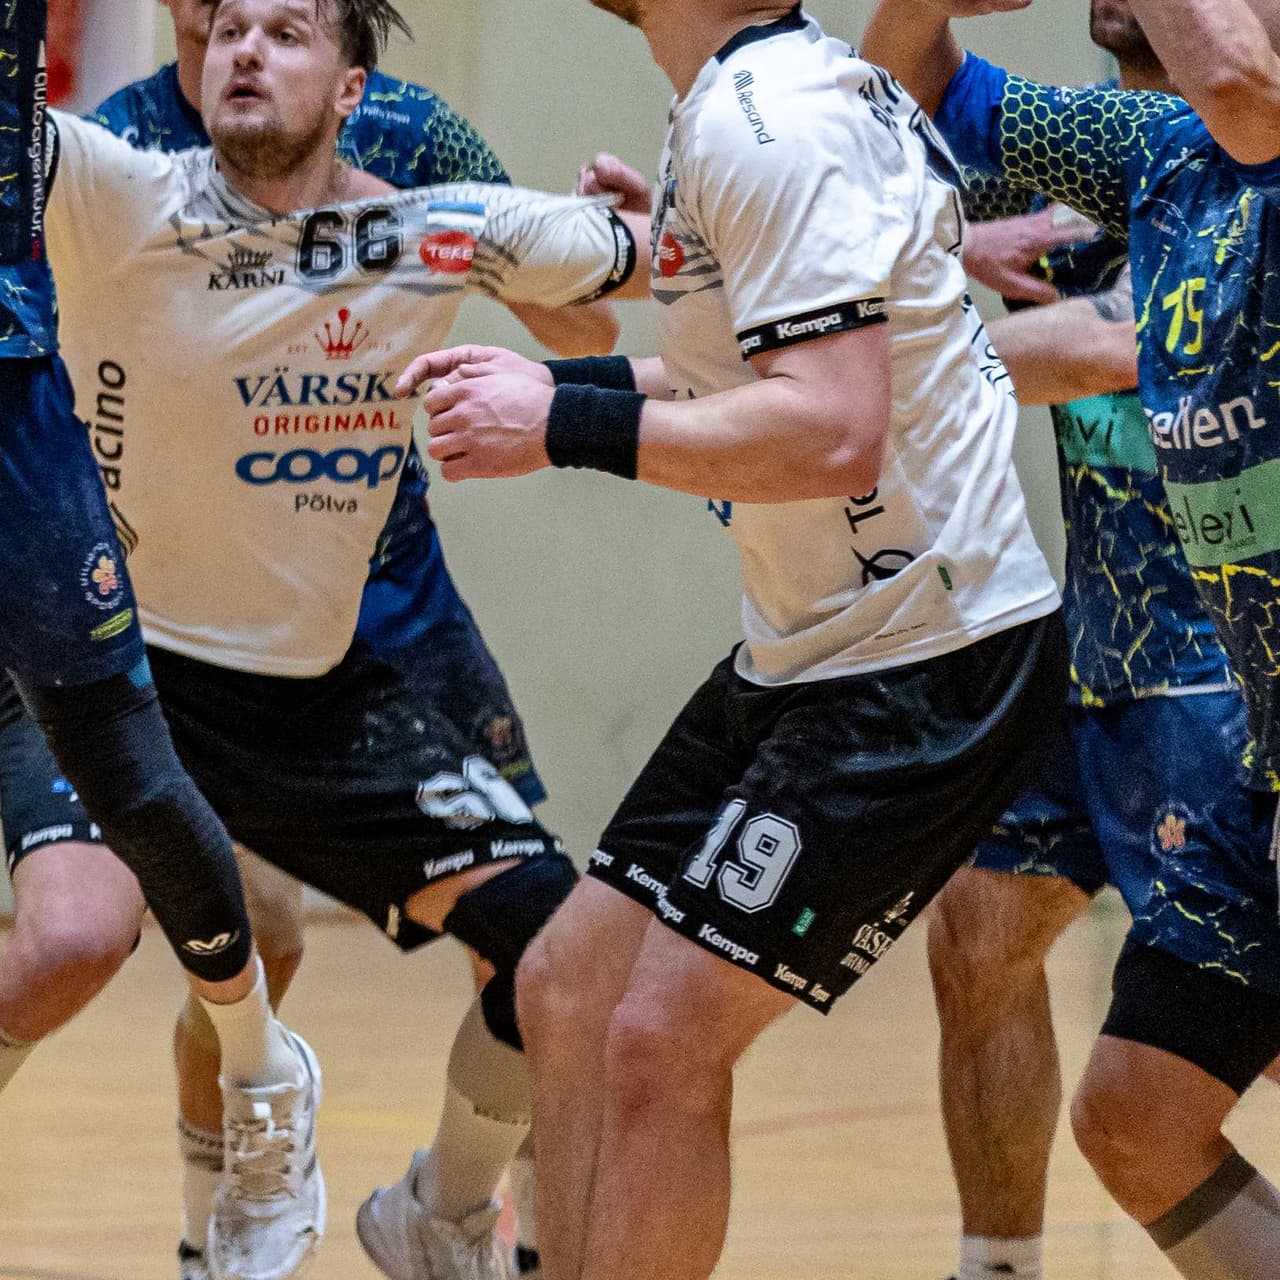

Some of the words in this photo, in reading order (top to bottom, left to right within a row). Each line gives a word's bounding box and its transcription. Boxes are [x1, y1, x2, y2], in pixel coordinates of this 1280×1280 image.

[737, 90, 776, 145] Resand
[296, 208, 404, 283] 66
[776, 312, 842, 340] Kempa
[1162, 276, 1207, 355] 15
[233, 366, 414, 407] VÄRSK
[253, 410, 402, 436] ORIGINAAL
[234, 442, 406, 489] coop
[294, 493, 359, 513] Põlva
[683, 798, 802, 914] 19
[698, 923, 760, 966] Kempa
